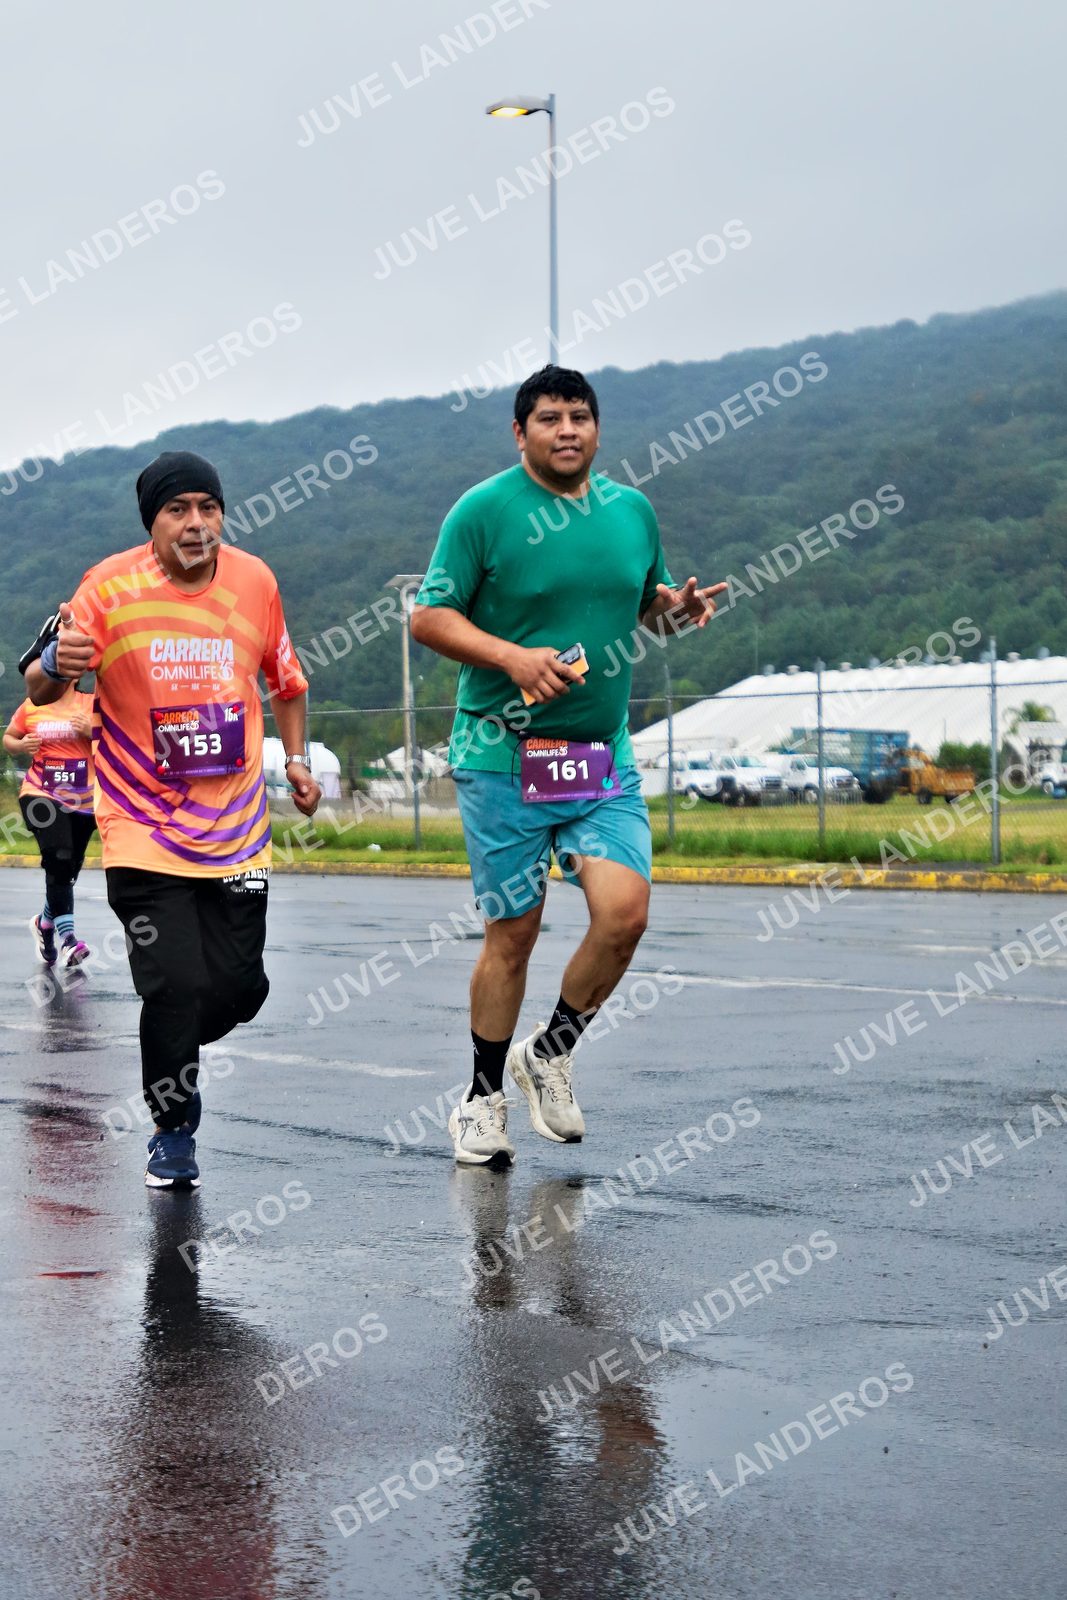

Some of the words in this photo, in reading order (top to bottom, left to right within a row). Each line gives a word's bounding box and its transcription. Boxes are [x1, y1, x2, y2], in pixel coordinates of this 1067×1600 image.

[150, 638, 234, 662] CARRERA
[178, 733, 223, 757] 153
[54, 771, 76, 783] 551
[547, 759, 590, 782] 161
